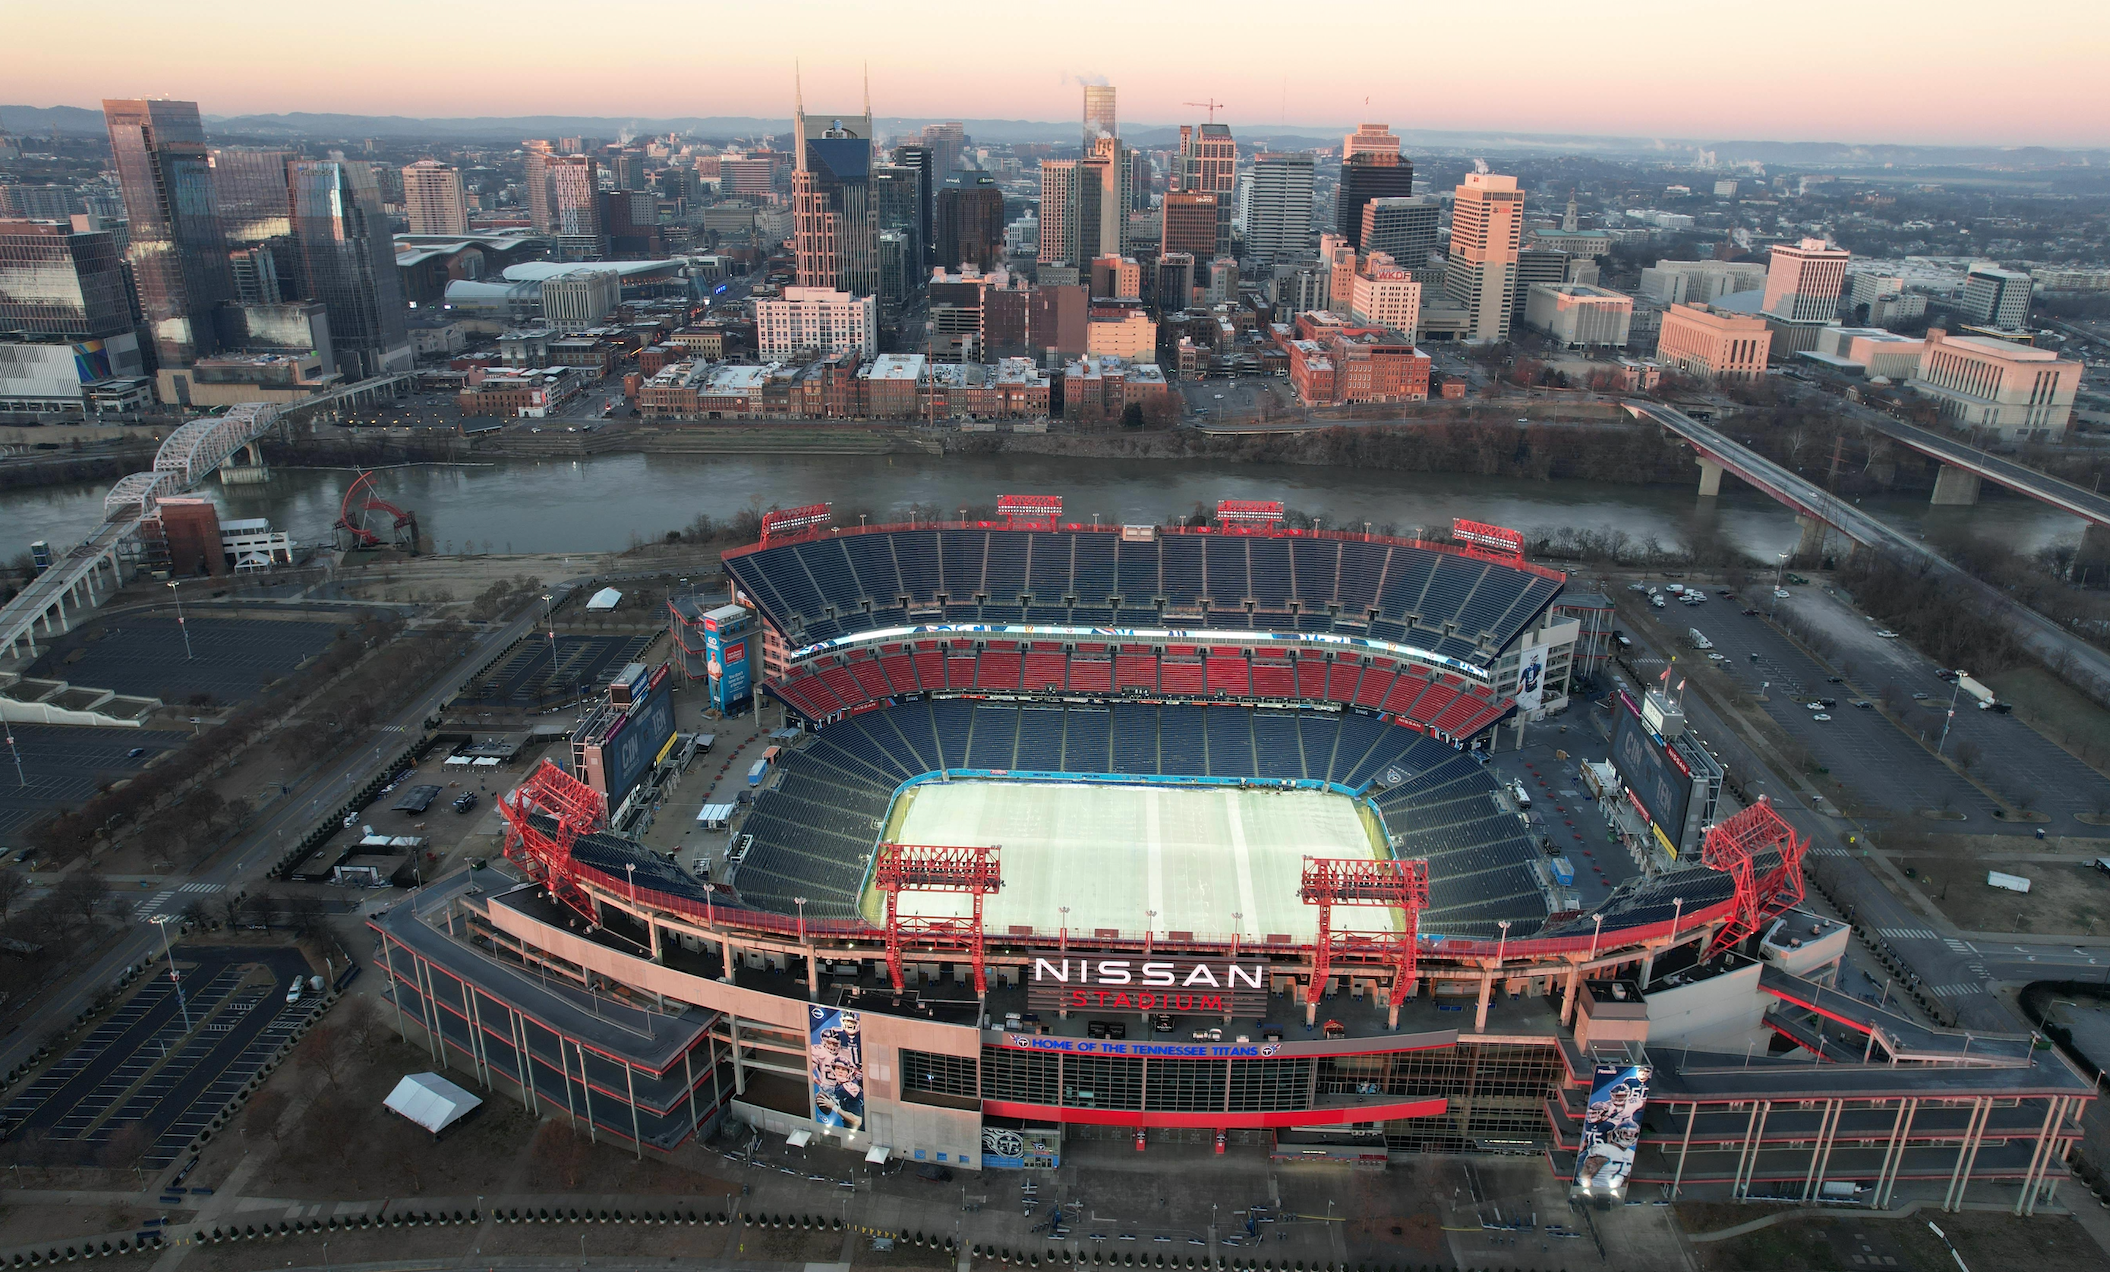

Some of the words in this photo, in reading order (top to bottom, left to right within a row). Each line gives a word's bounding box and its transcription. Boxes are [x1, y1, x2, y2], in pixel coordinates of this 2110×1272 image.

[299, 168, 333, 177] Pinnacle
[1378, 271, 1411, 280] WKDF
[853, 702, 876, 711] NISSAN
[652, 708, 667, 736] TEN
[1398, 717, 1421, 728] NISSAN
[622, 734, 639, 769] CIN
[1625, 731, 1643, 766] CIN
[1392, 764, 1412, 777] NISSAN
[1667, 748, 1687, 774] NISSAN
[1035, 957, 1263, 989] NISSAN
[1072, 990, 1223, 1011] STADIUM
[1032, 1038, 1073, 1051] HOME
[1077, 1041, 1097, 1052] OF
[1101, 1043, 1127, 1054] THE
[1131, 1044, 1207, 1056] TENNESSEE
[1211, 1046, 1258, 1057] TITANS
